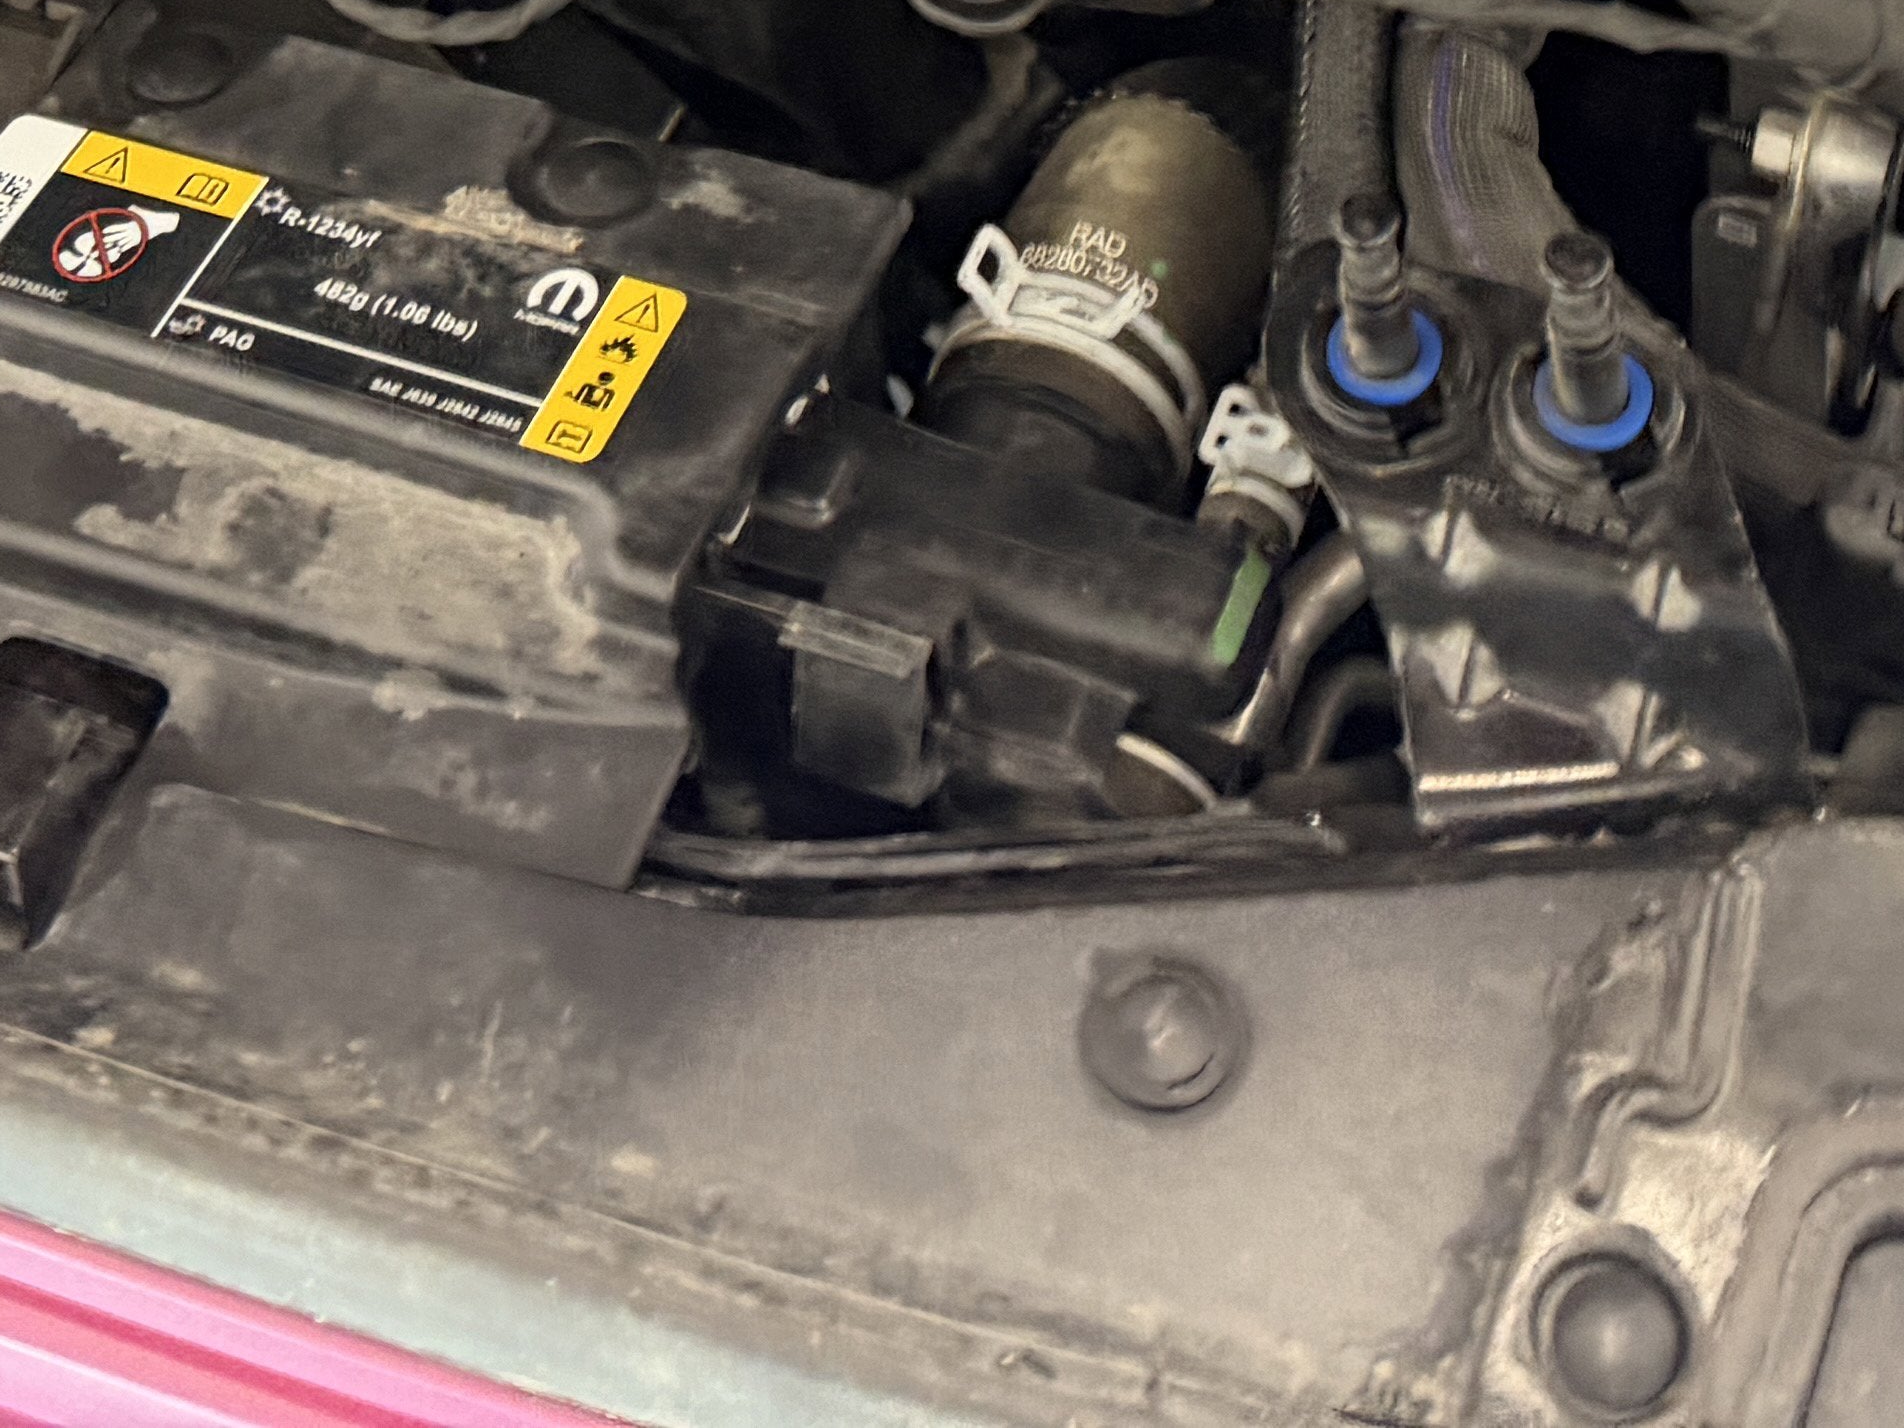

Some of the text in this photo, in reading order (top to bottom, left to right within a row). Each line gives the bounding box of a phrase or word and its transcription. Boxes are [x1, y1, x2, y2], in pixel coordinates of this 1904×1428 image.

[278, 207, 383, 249] R-1234yf
[1069, 219, 1127, 259] RAD
[313, 277, 370, 312] 482g
[431, 309, 478, 343] lbs)
